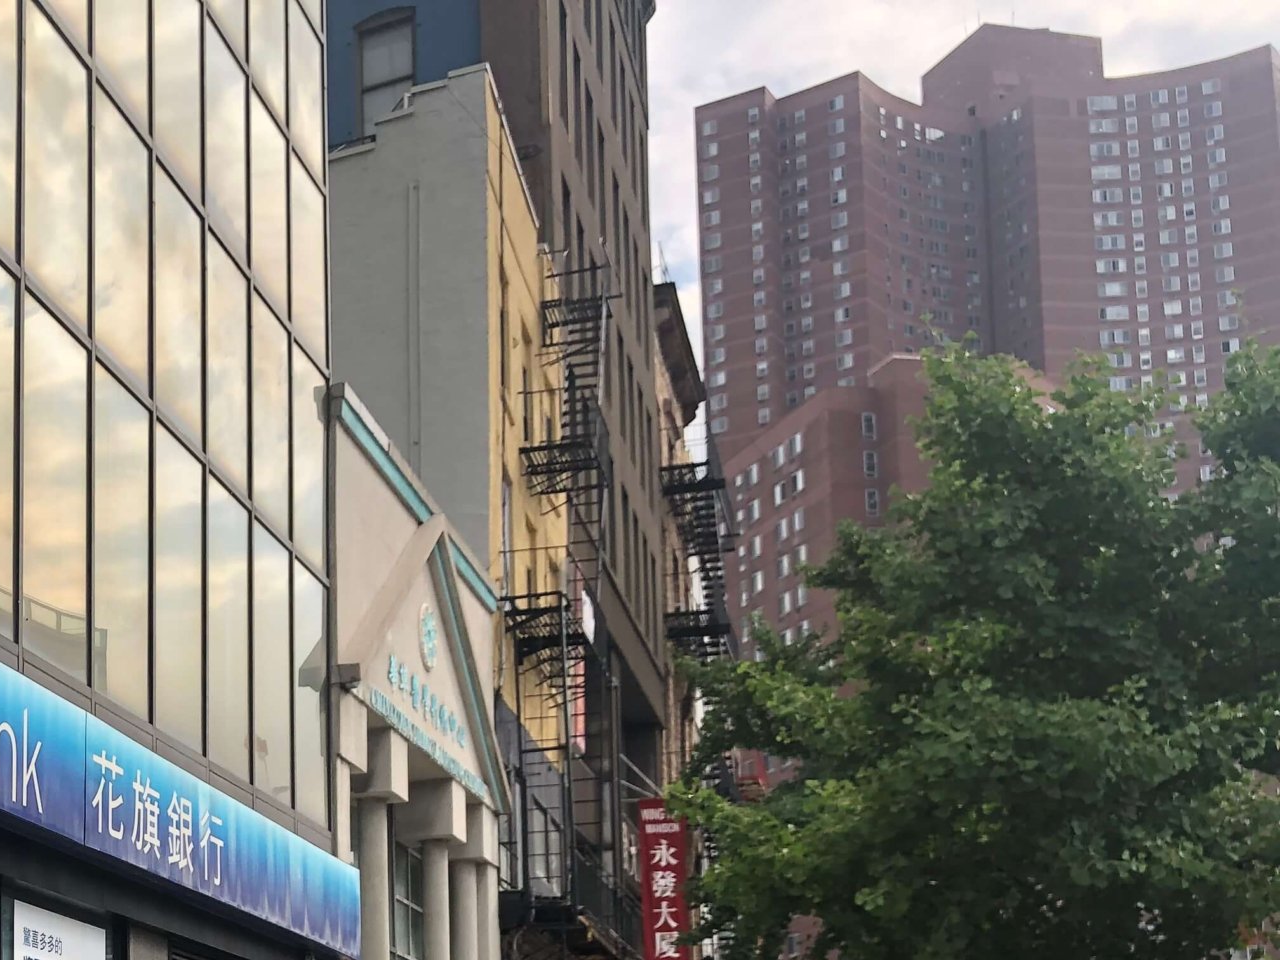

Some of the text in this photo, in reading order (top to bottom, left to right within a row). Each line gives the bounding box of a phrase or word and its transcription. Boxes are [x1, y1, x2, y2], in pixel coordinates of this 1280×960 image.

[91, 749, 226, 887] 花旗銀行
[23, 926, 63, 956] 驚喜多多的
[649, 838, 681, 958] 永發大廈
